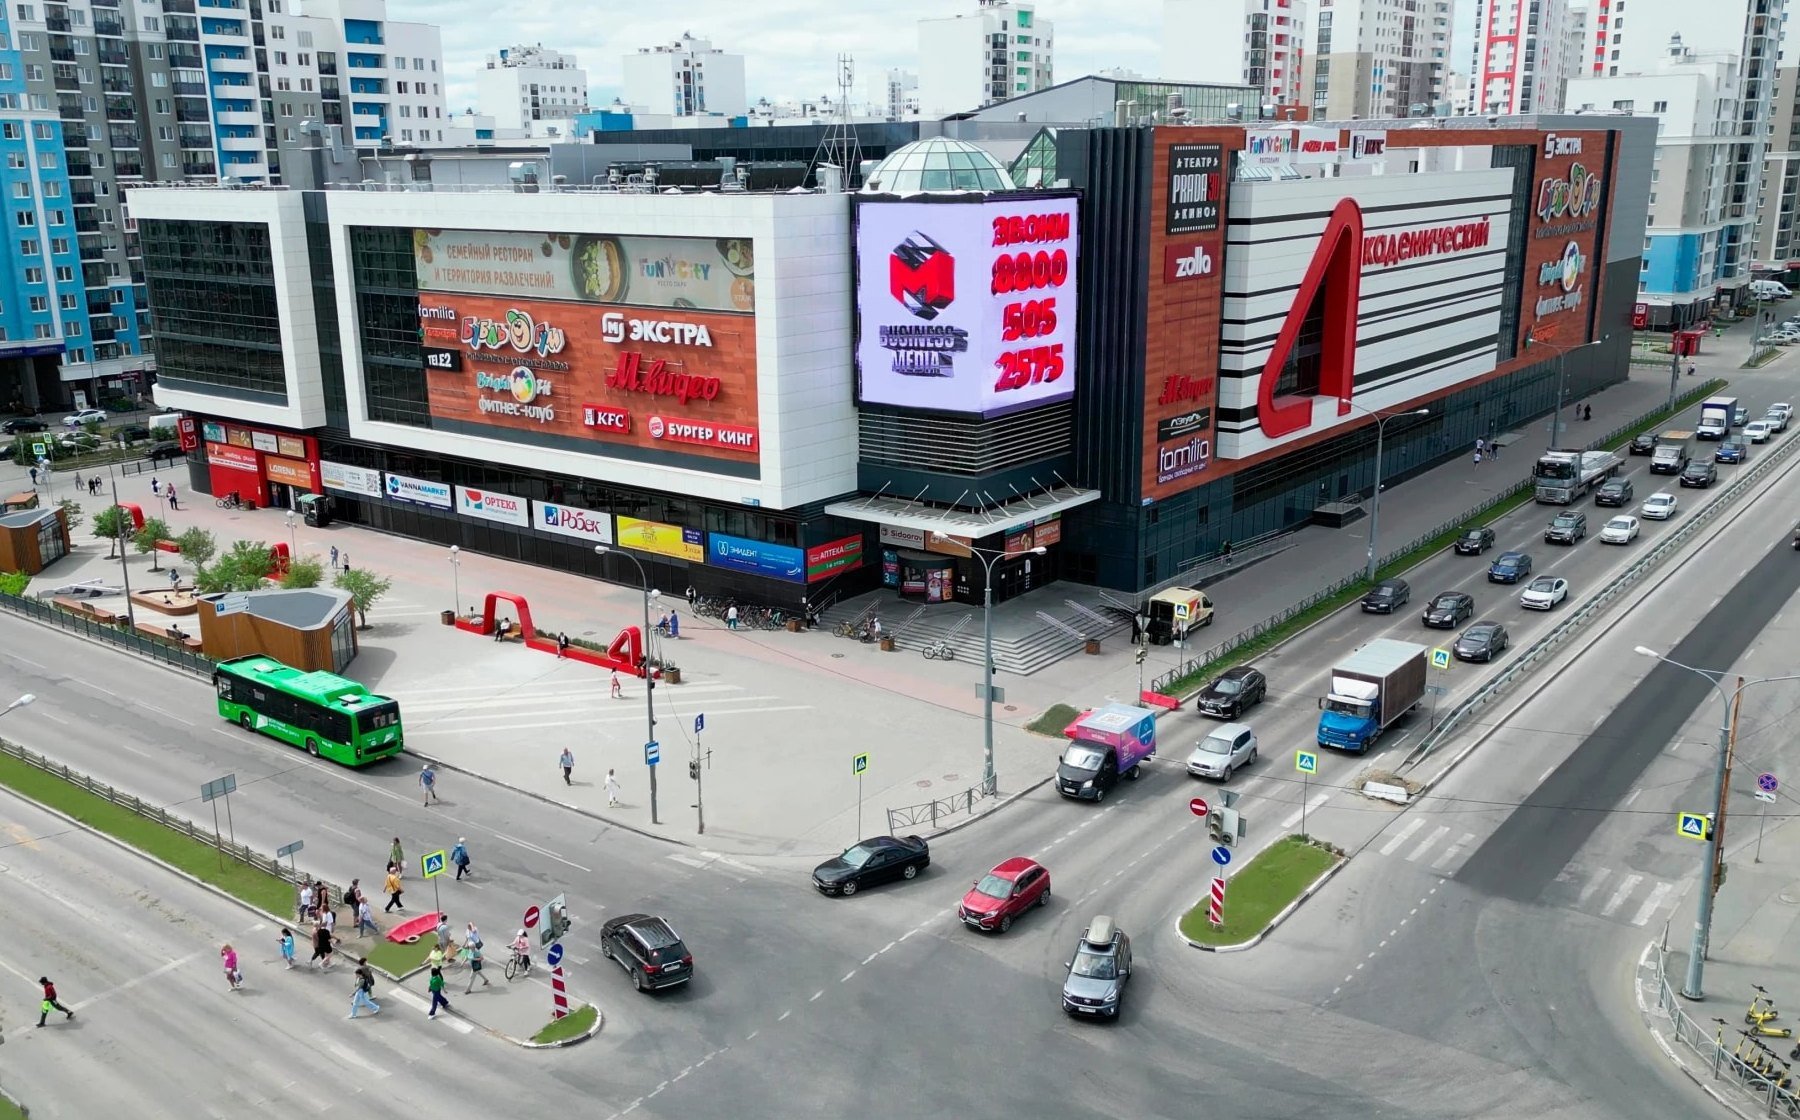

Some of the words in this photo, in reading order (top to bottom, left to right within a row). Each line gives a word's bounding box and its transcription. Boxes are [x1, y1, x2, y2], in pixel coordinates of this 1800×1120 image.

[1555, 138, 1582, 156] ЭКСТРА
[1184, 157, 1212, 168] ТЕАТР
[1172, 173, 1208, 204] PRADA
[1181, 206, 1211, 220] КИНО
[992, 212, 1070, 247] ЗВОНИ
[446, 242, 491, 261] СЕМЕЙНЫЙ
[492, 246, 534, 263] РЕСТОРАН
[1175, 246, 1211, 277] zolla
[434, 268, 440, 281] И
[442, 268, 492, 285] ТЕРРИТОРИЯ
[494, 270, 555, 288] РАЗВЛЕЧЕНИЙ!
[991, 248, 1069, 296] 8800
[418, 303, 456, 320] familia
[1001, 297, 1058, 342] 505
[629, 318, 712, 347] ЭКСТРА
[879, 324, 957, 350] BUSINESS
[427, 353, 452, 368] TELE2
[890, 349, 942, 374] MEDIA
[994, 343, 1065, 393] 2575
[478, 394, 555, 424] фитнес-клуб
[598, 411, 624, 427] KFC
[668, 423, 713, 440] БУРГЕР
[718, 430, 753, 446] КИНГ
[1160, 437, 1209, 473] familia
[269, 463, 296, 476] LORENA
[310, 462, 316, 472] 2
[400, 481, 448, 496] VANNAMARKET
[560, 508, 602, 535] Робек
[729, 546, 758, 557] ЭНИДЕНТ
[819, 544, 844, 559] АПТЕКА
